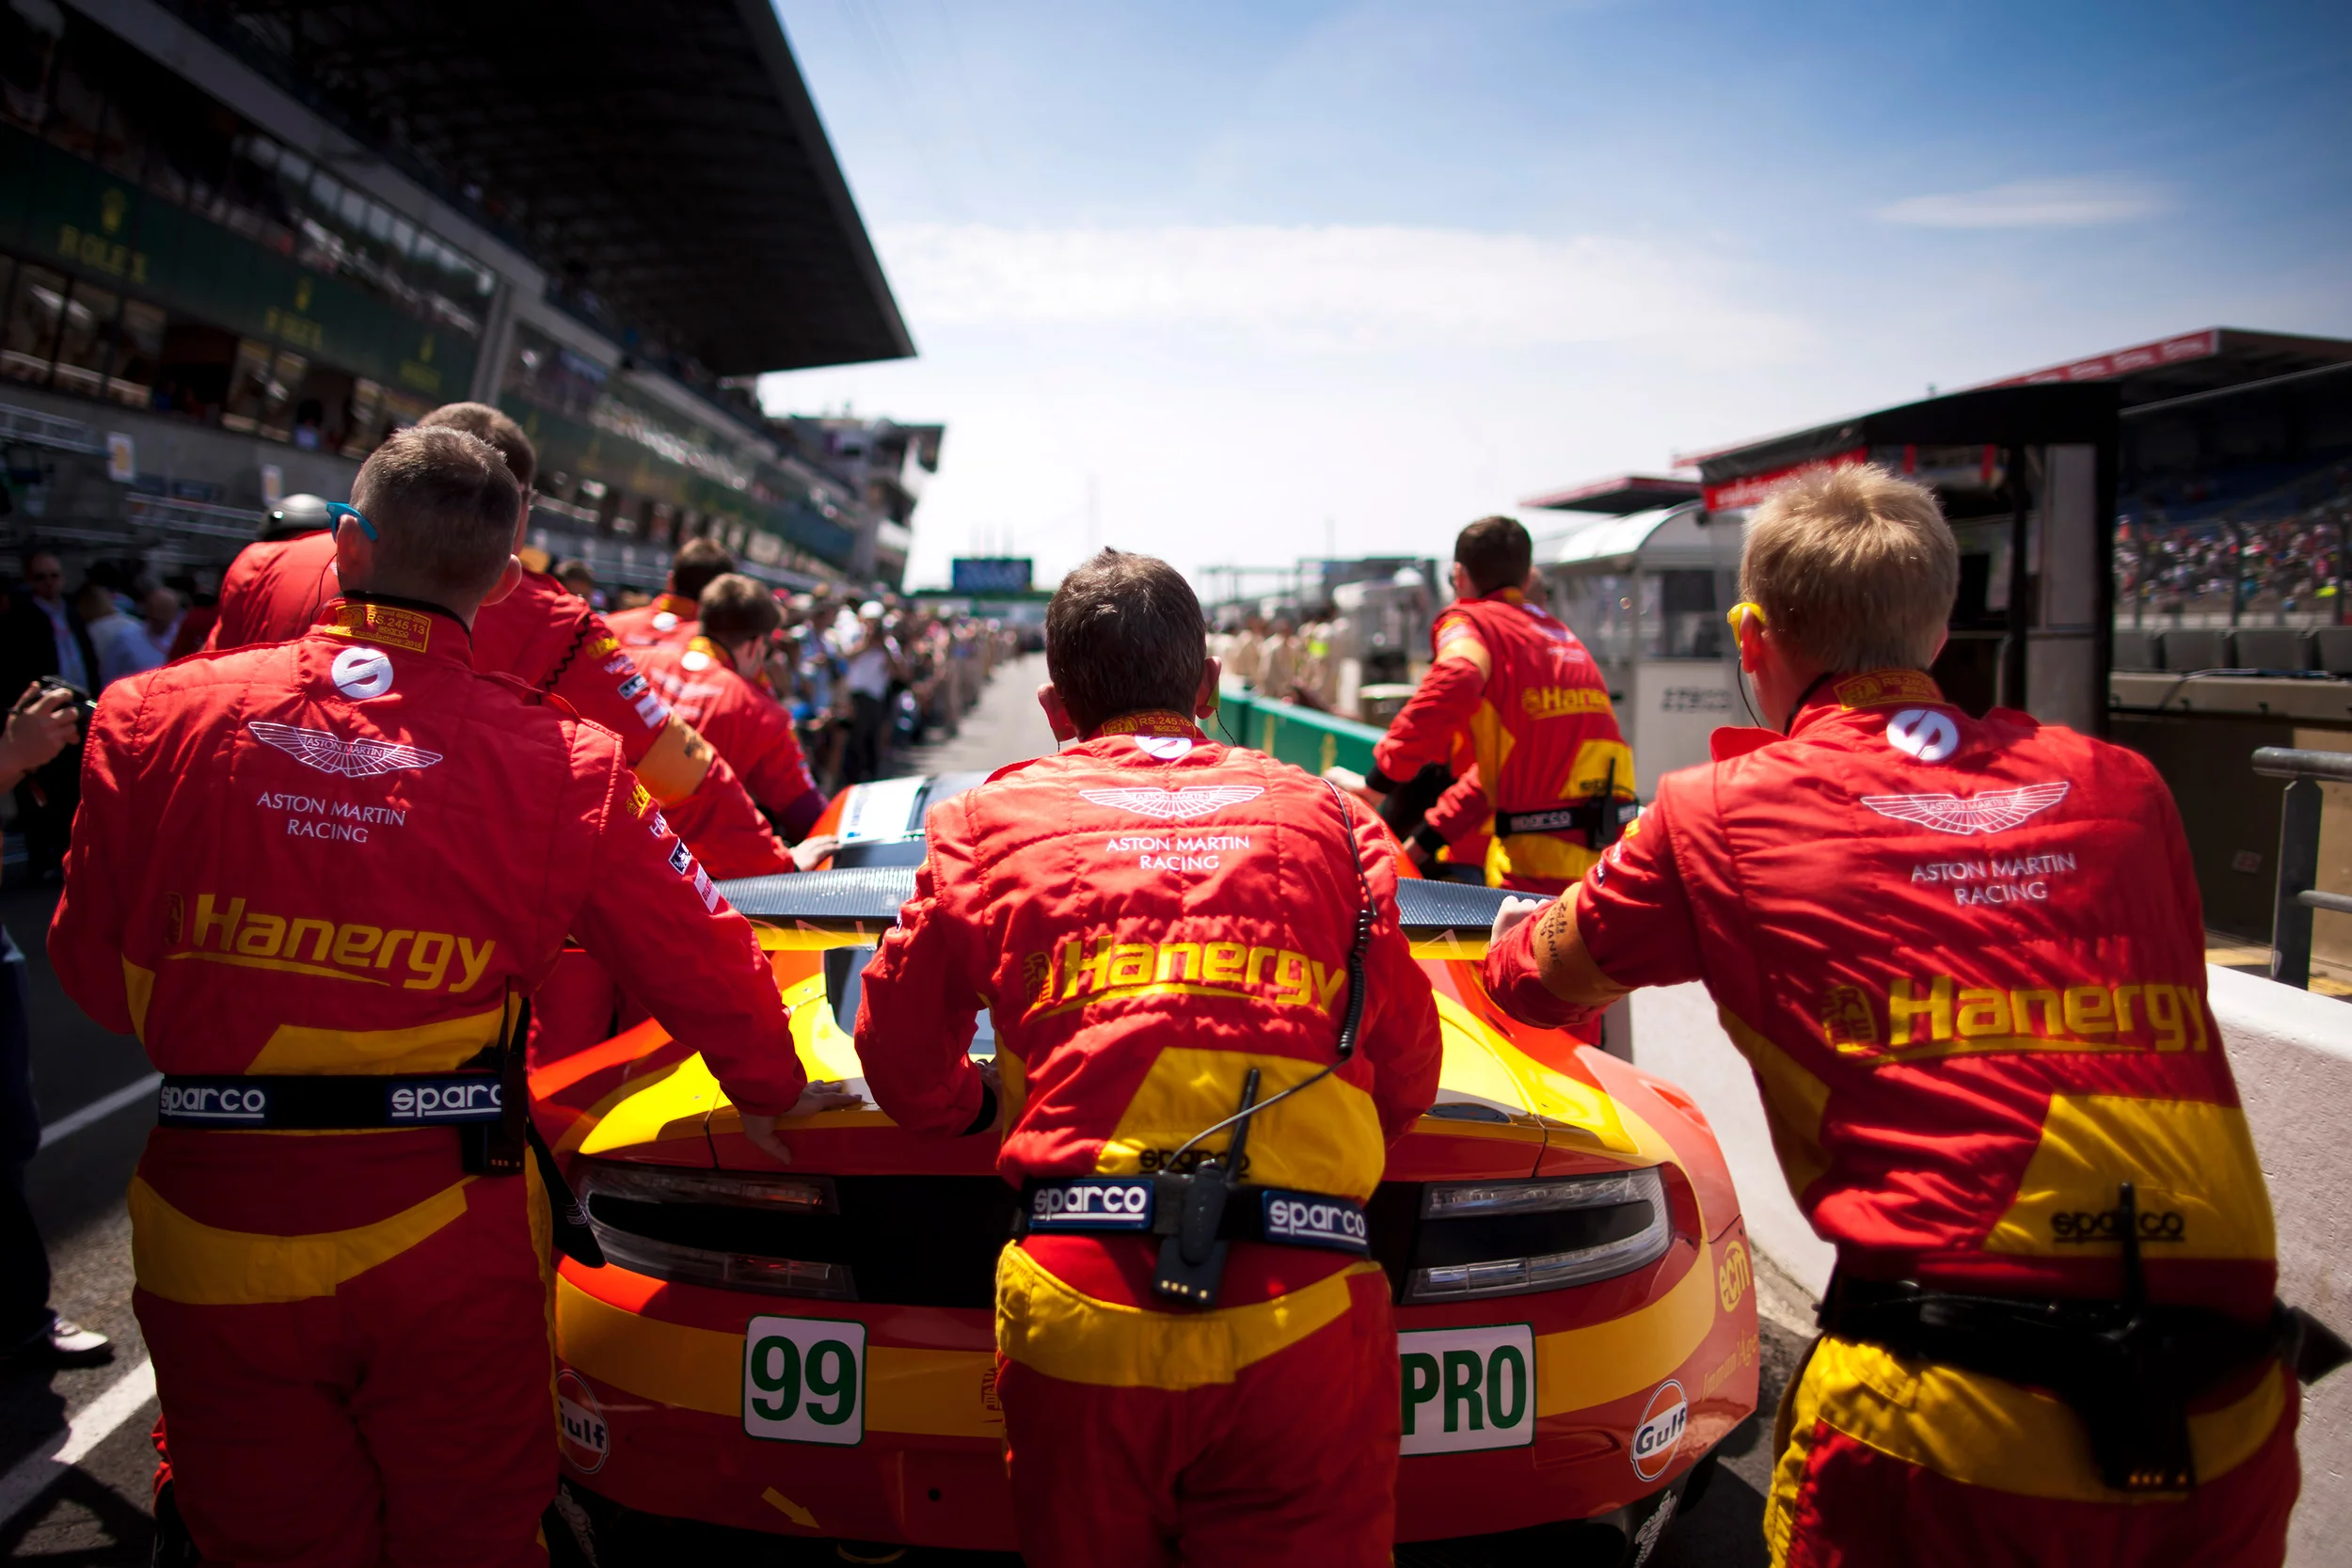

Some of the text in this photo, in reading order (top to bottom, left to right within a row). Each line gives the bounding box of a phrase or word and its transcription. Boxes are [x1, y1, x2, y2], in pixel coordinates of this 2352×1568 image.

[367, 612, 425, 635] RS.245.13
[1139, 716, 1191, 728] RS.245.13
[307, 736, 384, 758] ASTON MARTIN
[256, 791, 406, 826] ASTON MARTIN
[1172, 792, 1210, 800] MARTIN
[1929, 798, 2010, 811] ASTON MARTIN
[287, 818, 369, 843] RACING
[1105, 835, 1250, 852] ASTON MARTIN
[1139, 855, 1219, 871] RACING
[1911, 852, 2077, 883] ASTON MARTIN
[1953, 881, 2048, 906] RACING
[192, 893, 497, 993] Hanergy
[1062, 934, 1347, 1017] Hanergy
[1889, 974, 2208, 1053] Hanergy
[160, 1085, 266, 1117] sparco
[1033, 1184, 1148, 1221] sparco
[1269, 1198, 1368, 1241] sparco
[2050, 1209, 2185, 1242] spaco
[750, 1335, 858, 1426] 99
[1401, 1343, 1528, 1436] PRO
[1634, 1406, 1687, 1456] Gulf
